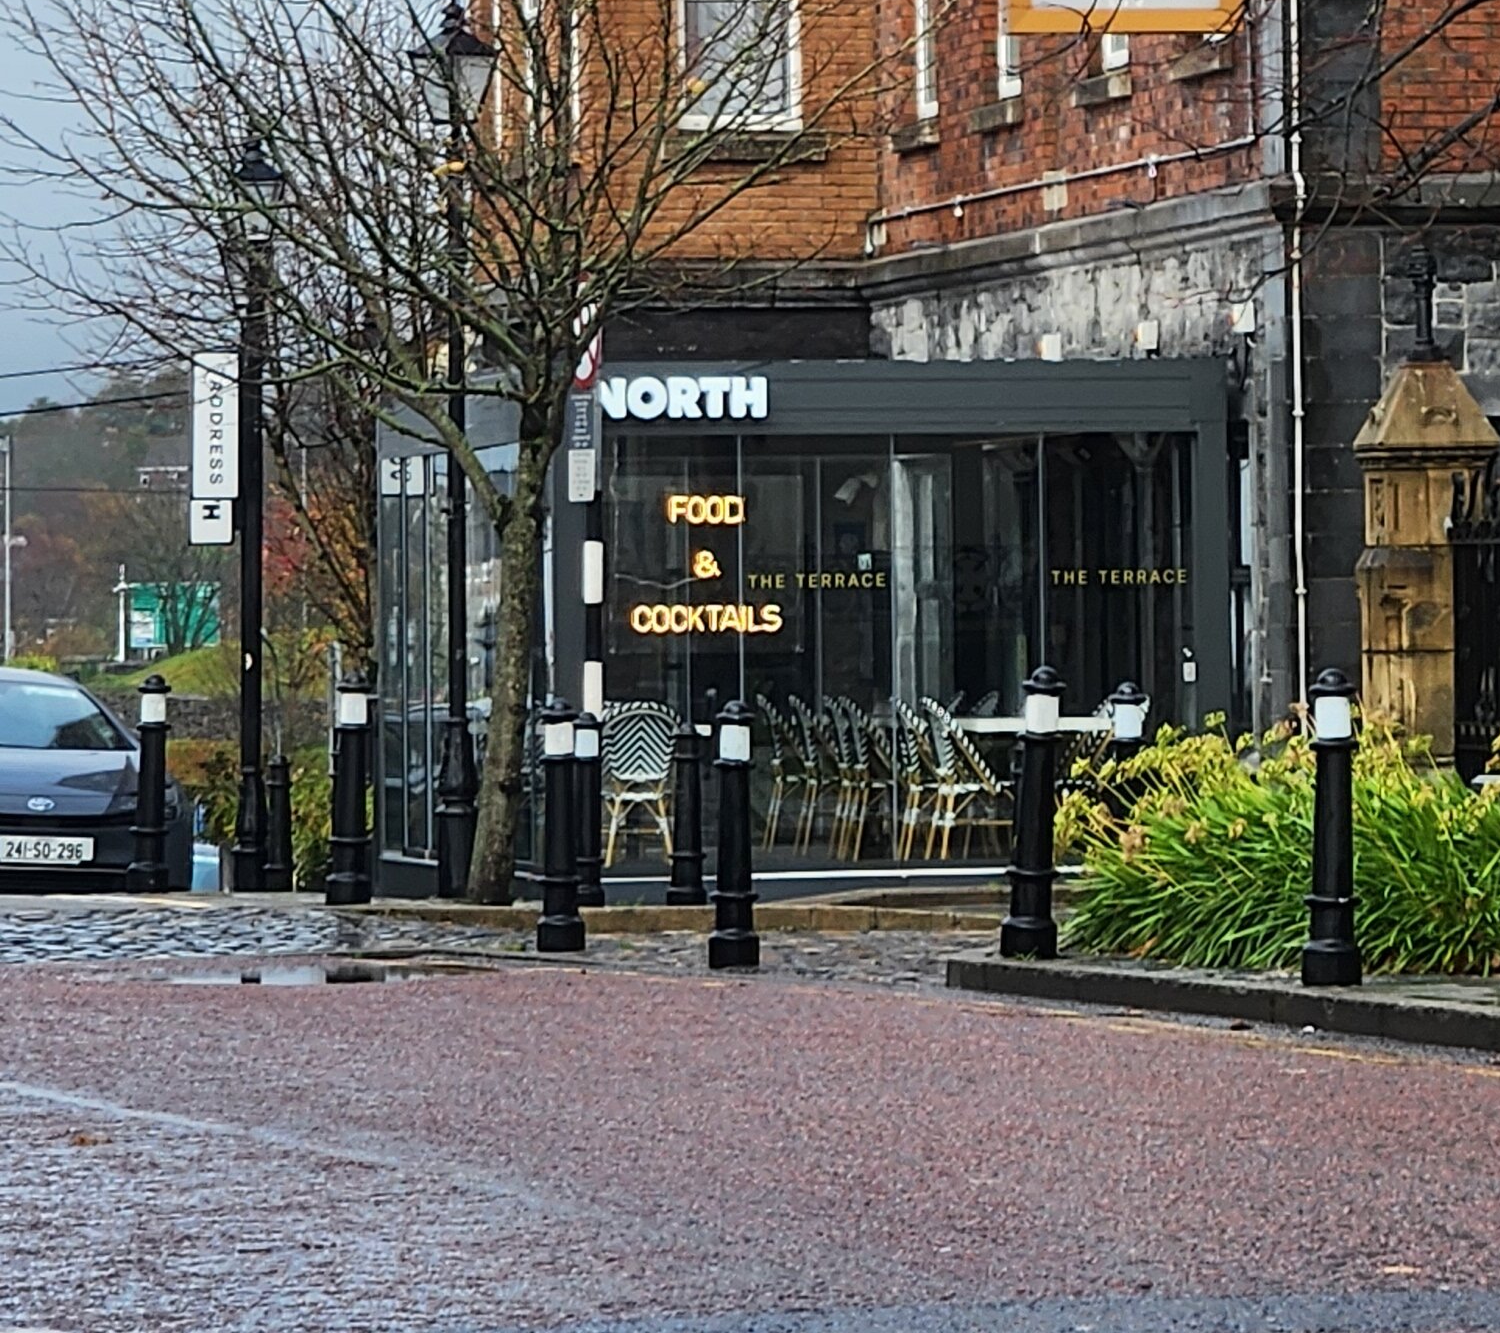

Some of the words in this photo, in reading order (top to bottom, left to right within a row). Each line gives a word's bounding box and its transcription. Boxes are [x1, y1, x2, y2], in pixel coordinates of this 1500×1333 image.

[599, 376, 768, 419] NORTH
[209, 380, 224, 485] ADDRESS
[668, 495, 744, 525] FOOD
[694, 550, 722, 579] &
[1051, 570, 1088, 585] THE
[1098, 569, 1187, 585] TERRACE
[748, 574, 785, 589] THE
[796, 573, 886, 589] TERRACE
[631, 604, 783, 633] COCKTAILS
